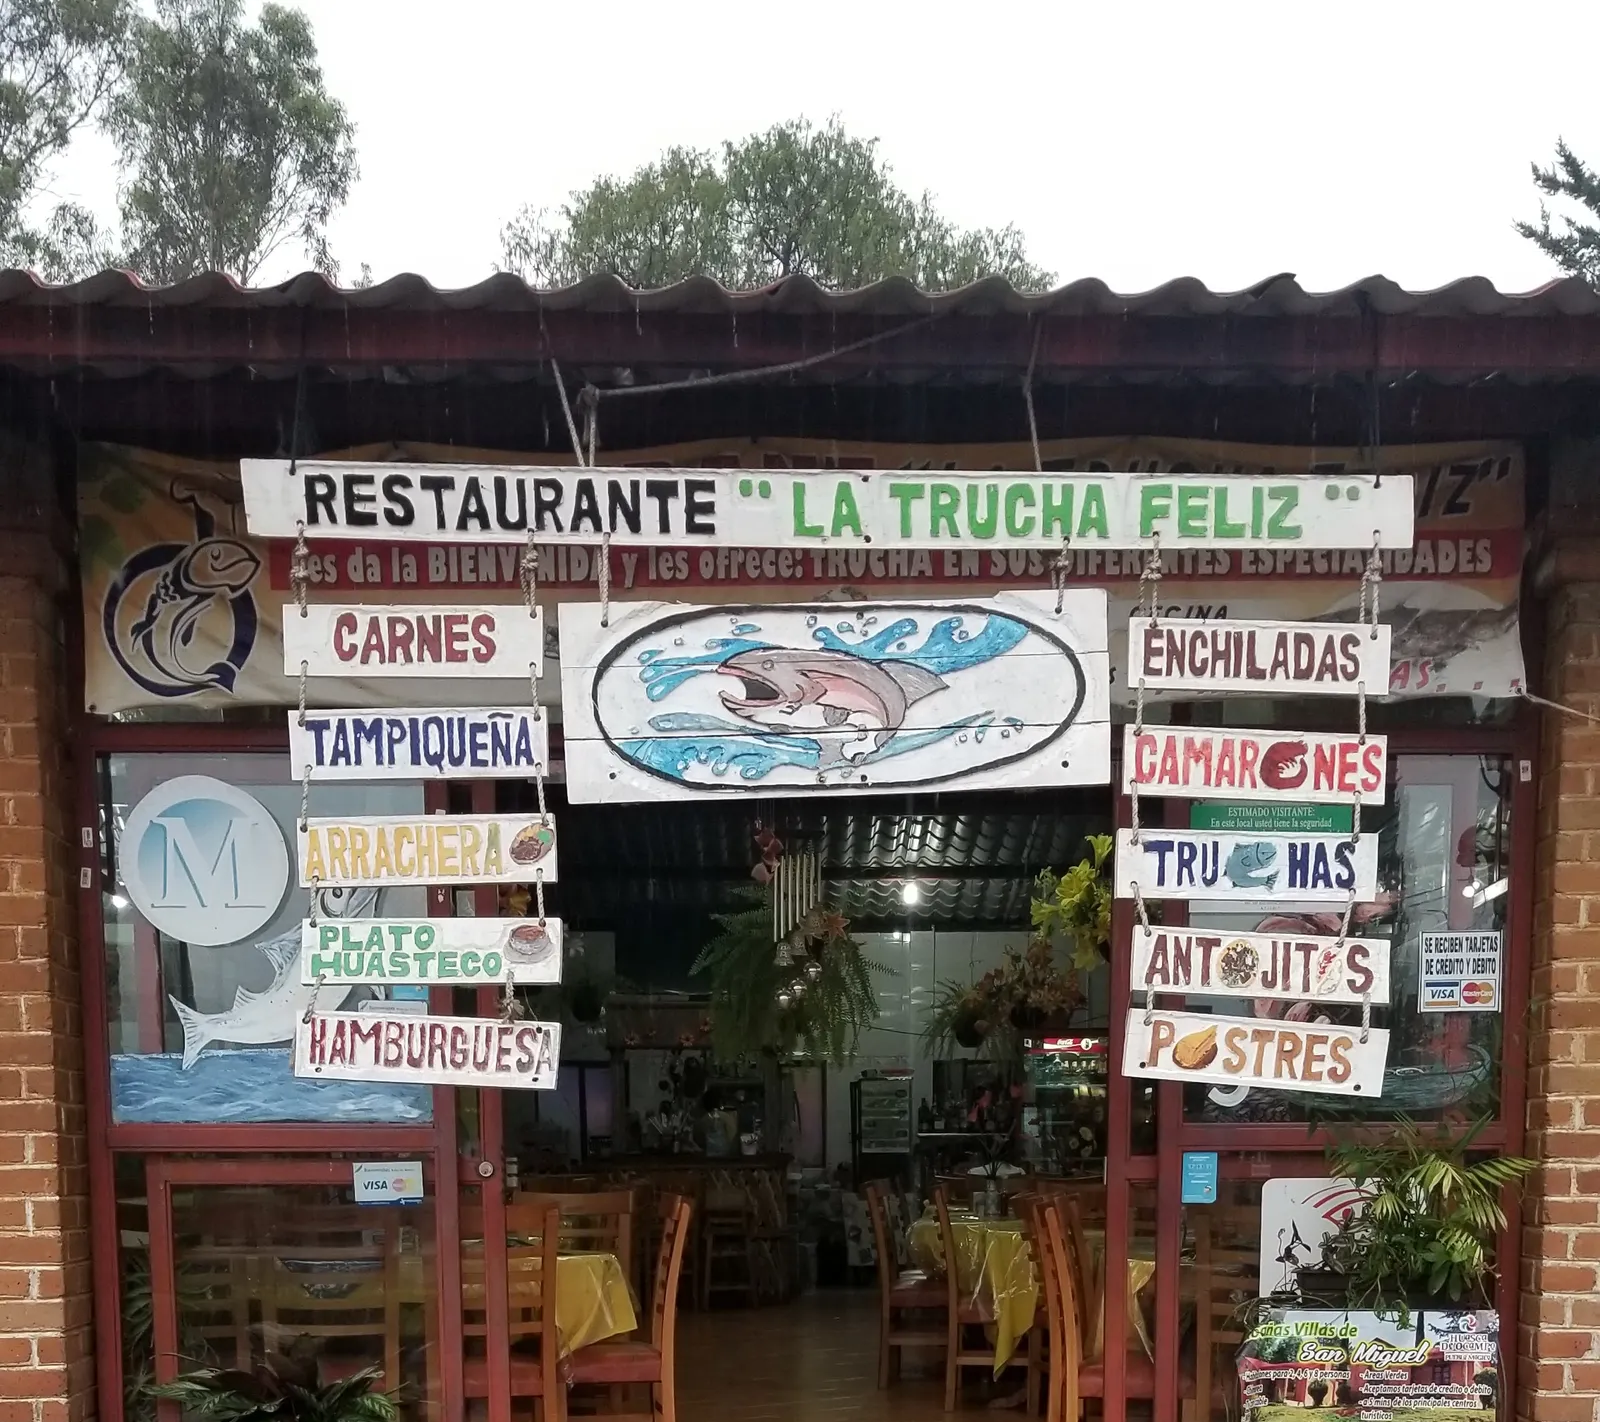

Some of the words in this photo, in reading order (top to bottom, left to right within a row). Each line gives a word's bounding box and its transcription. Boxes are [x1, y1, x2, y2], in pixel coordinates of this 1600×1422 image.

[304, 473, 716, 534] RESTAURANTE
[792, 480, 863, 538] LA
[889, 482, 1110, 539] TRUCHA
[1139, 483, 1304, 540] FELIZ
[347, 546, 381, 583] da
[391, 546, 417, 583] la
[428, 545, 613, 583] BIENVNIDA
[621, 552, 638, 589] y
[648, 546, 690, 581] les
[699, 548, 804, 580] ofrece:
[809, 549, 934, 578] TRUCHA
[944, 549, 980, 577] EN
[990, 548, 1044, 577] SUS
[1061, 548, 1231, 576] DIFERNTES
[1241, 539, 1492, 575] ESPECIAIDADES
[334, 612, 497, 663] CARNES
[1142, 627, 1361, 683] ENCHILADAS
[305, 713, 536, 771] TAMPIQUEÑA
[1228, 807, 1269, 817] ESTIMADO
[1271, 807, 1315, 817] VISITANTE:
[1211, 818, 1220, 828] En
[1221, 819, 1235, 828] este
[1237, 818, 1253, 828] local
[1254, 818, 1272, 828] usted
[1274, 818, 1290, 828] tiene
[1292, 818, 1299, 828] la
[1300, 818, 1332, 830] seguridad
[304, 823, 504, 882] ARRACHERA
[318, 924, 436, 952] PLATO
[1424, 937, 1433, 953] SE
[1434, 936, 1463, 953] RECIBEN
[1465, 936, 1498, 953] TARJETAS
[311, 950, 503, 978] HUASTECO
[1425, 958, 1434, 975] DE
[1435, 954, 1464, 975] CRÉDITO
[1466, 958, 1471, 975] Y
[1472, 953, 1496, 975] DÉBITO
[1430, 989, 1455, 999] VISA
[309, 1020, 557, 1076] HAMBURGUESA
[363, 1180, 389, 1190] VISA
[1294, 1322, 1336, 1338] Villas
[1339, 1322, 1358, 1337] de
[1300, 1342, 1344, 1362] San
[1352, 1340, 1430, 1368] Miguel
[1272, 1371, 1288, 1380] para
[1320, 1371, 1350, 1380] personas
[1385, 1370, 1408, 1380] Verdes
[1363, 1384, 1401, 1395] Aceptamos
[1402, 1384, 1428, 1395] tarjetas
[1429, 1383, 1438, 1393] de
[1374, 1398, 1391, 1406] mins
[1392, 1397, 1401, 1406] de
[1402, 1398, 1412, 1407] los
[1413, 1398, 1451, 1409] principales
[1451, 1399, 1477, 1408] centros
